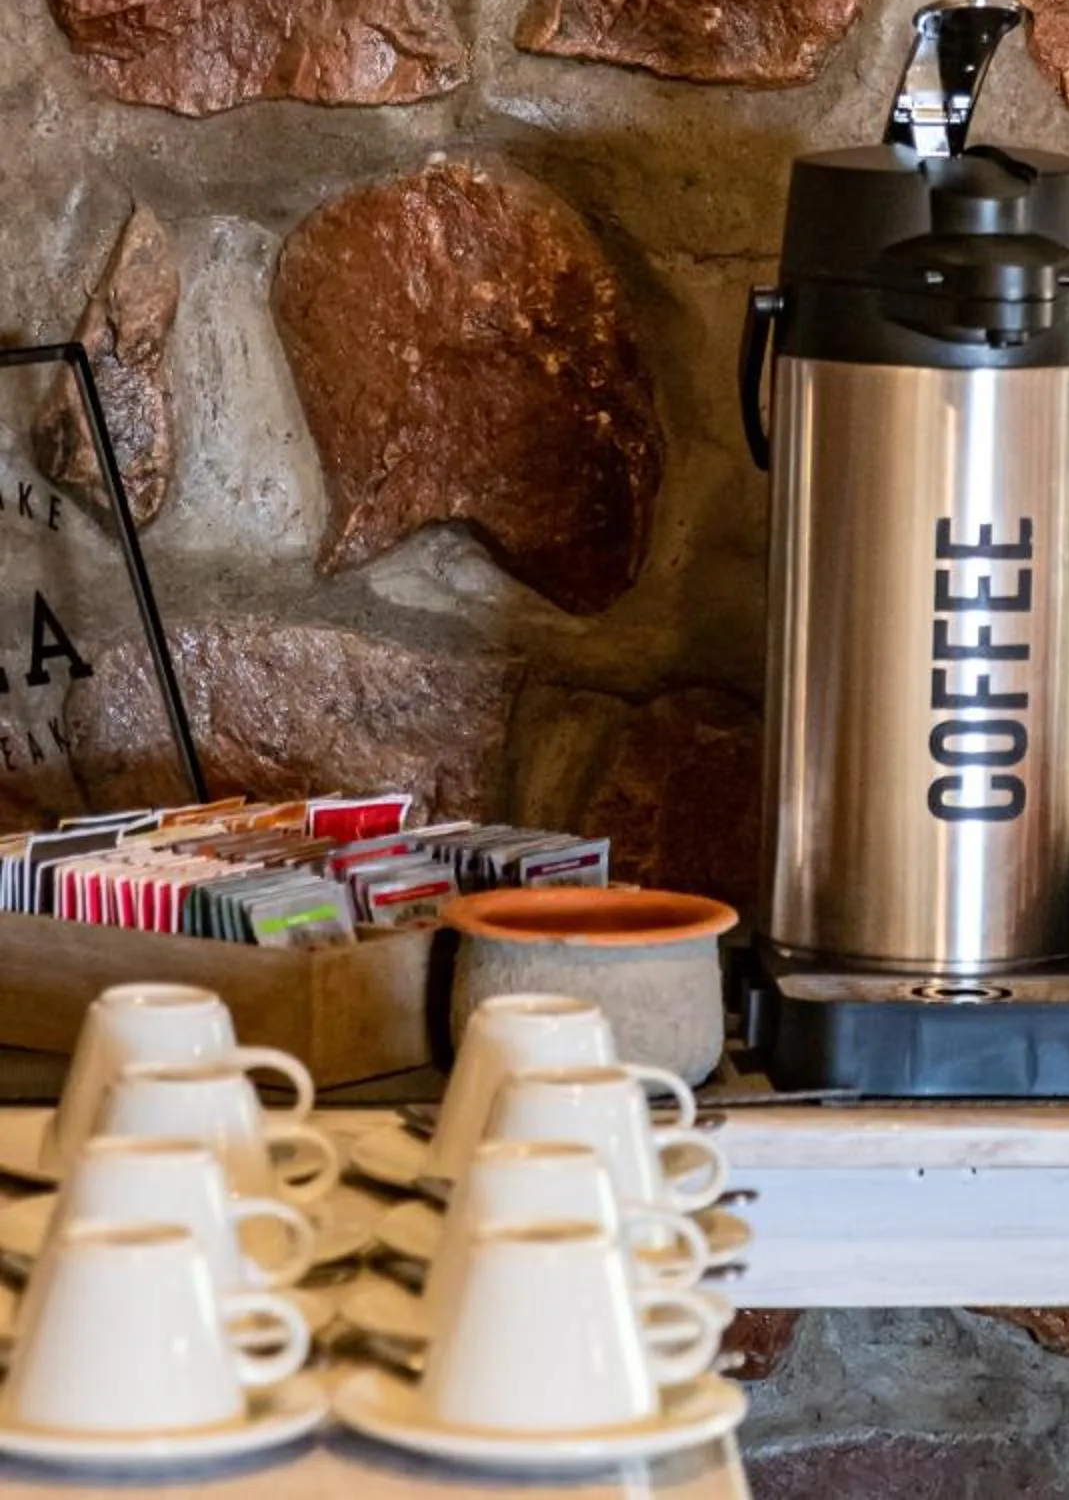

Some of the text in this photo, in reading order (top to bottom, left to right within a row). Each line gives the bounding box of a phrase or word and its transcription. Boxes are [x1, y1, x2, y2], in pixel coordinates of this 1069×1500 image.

[0, 481, 62, 531] KE
[0, 589, 94, 687] A
[927, 516, 1033, 822] COFFEE
